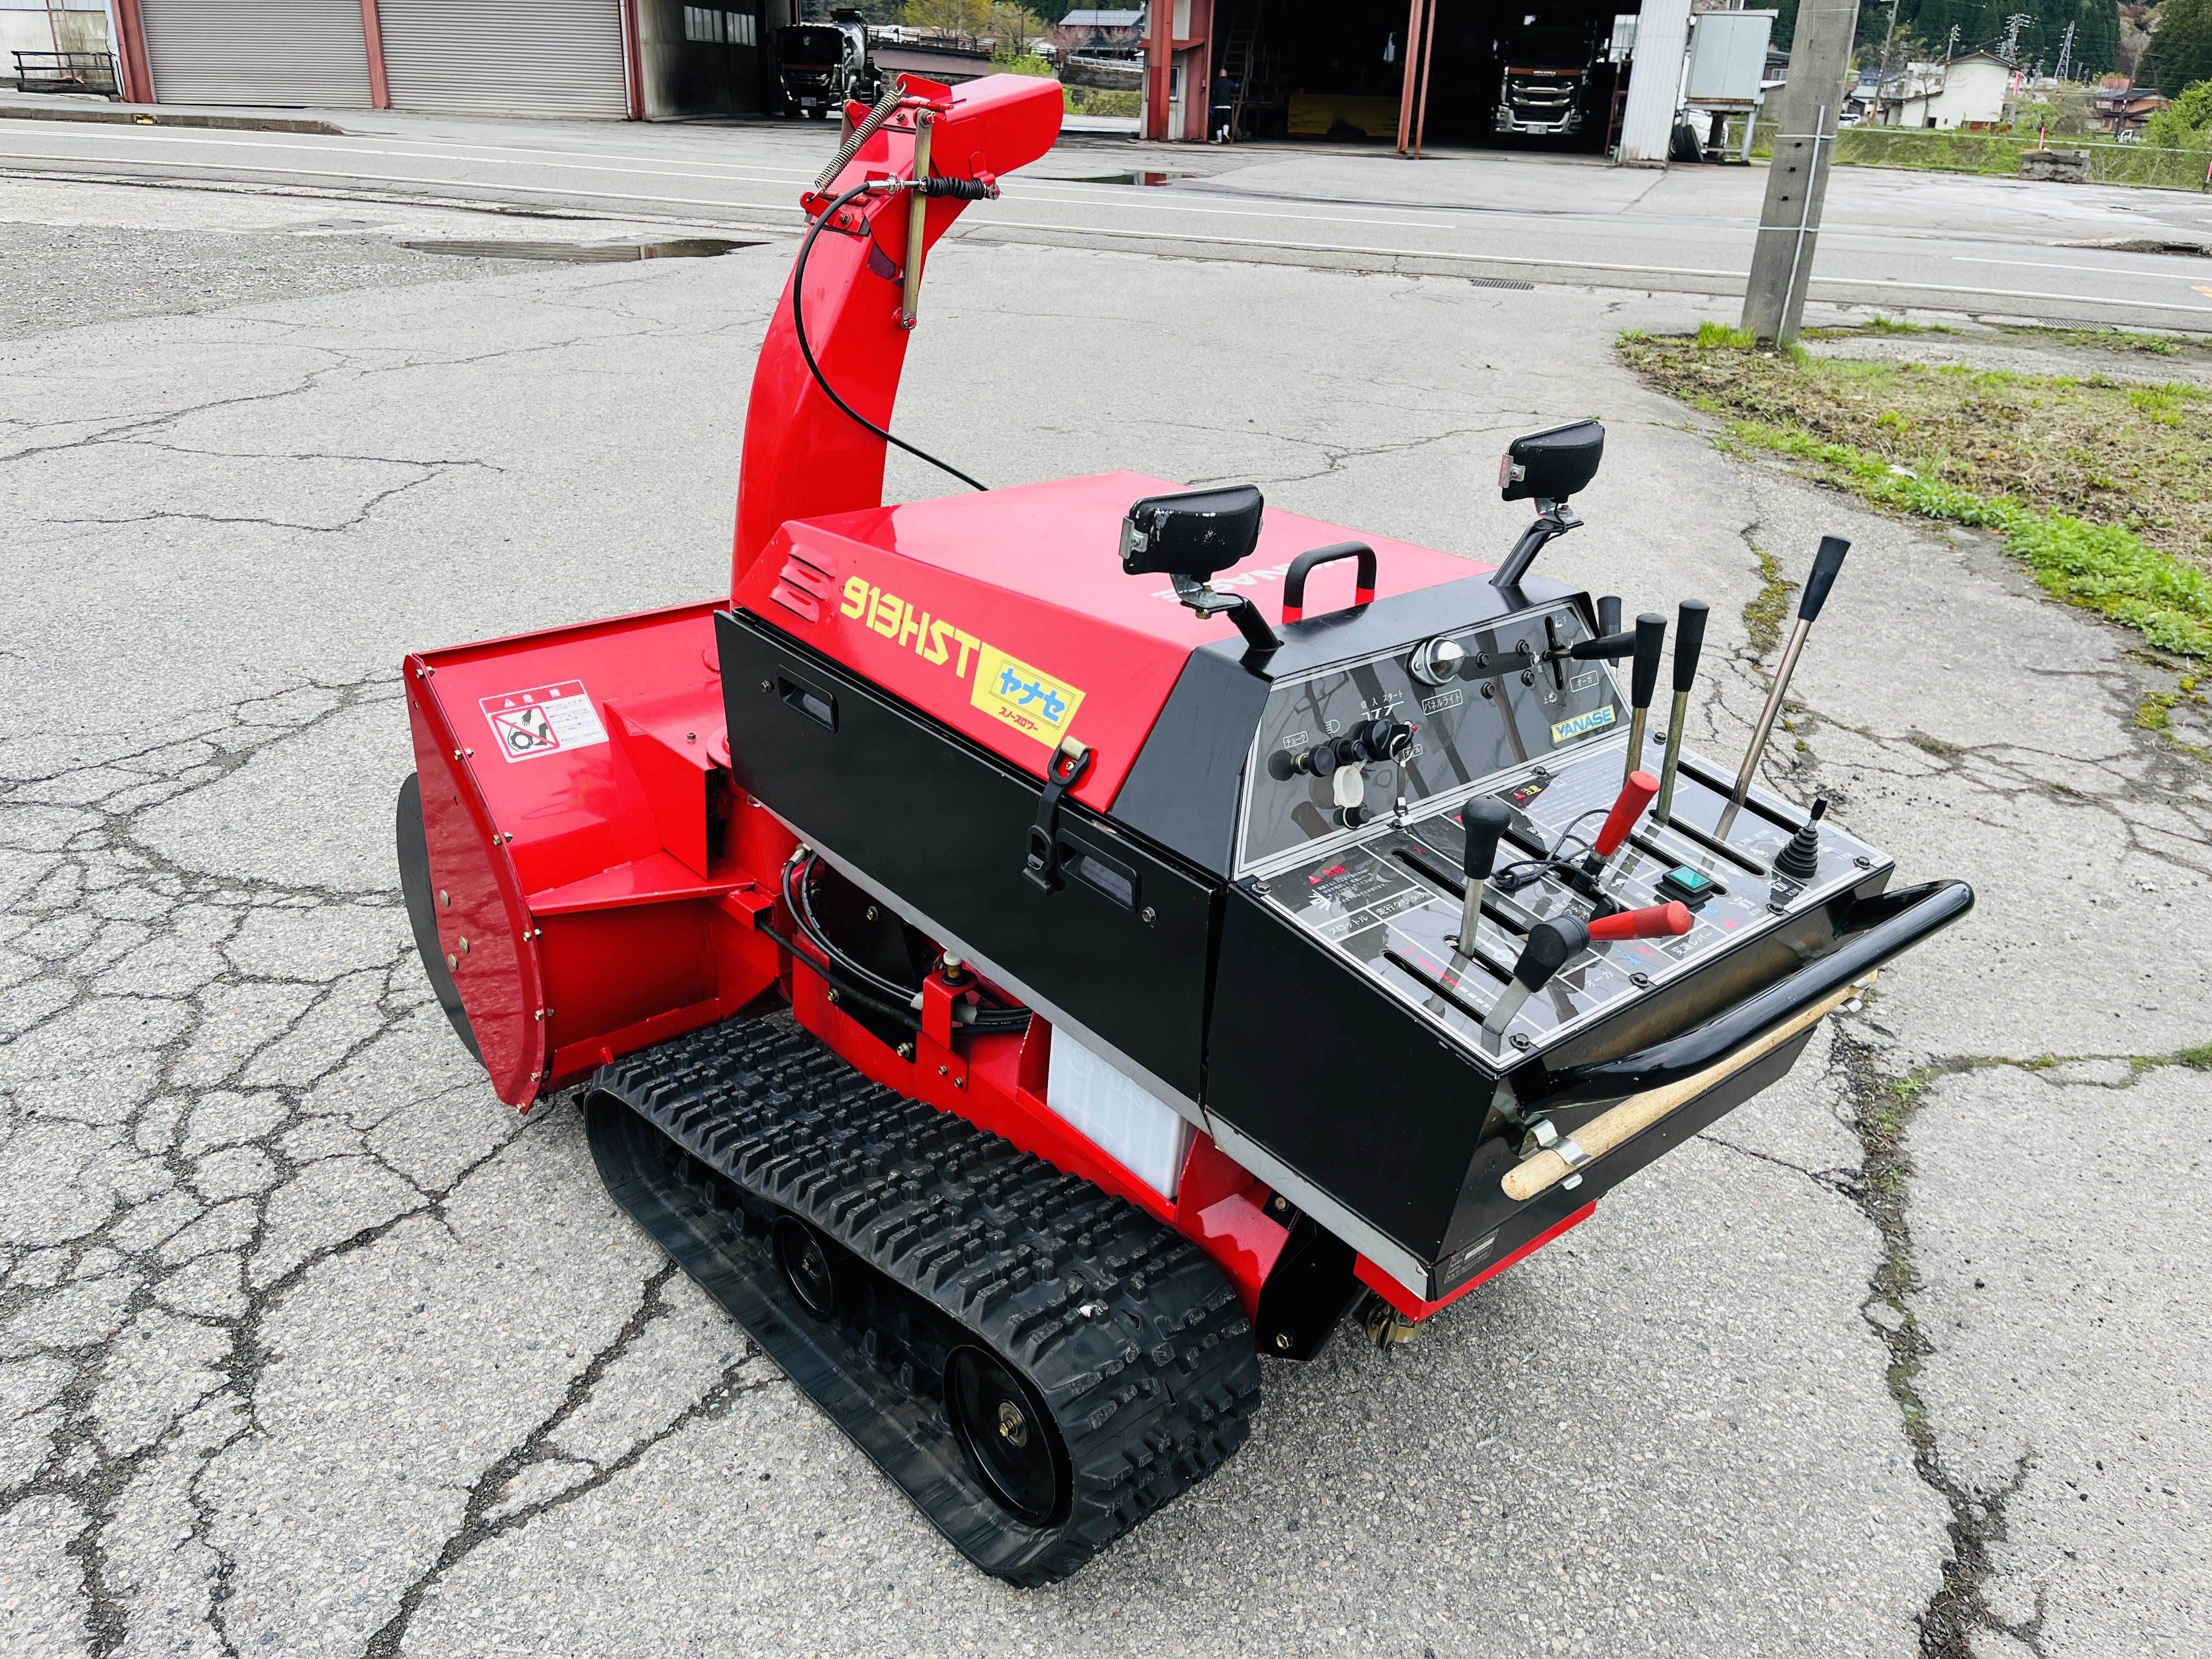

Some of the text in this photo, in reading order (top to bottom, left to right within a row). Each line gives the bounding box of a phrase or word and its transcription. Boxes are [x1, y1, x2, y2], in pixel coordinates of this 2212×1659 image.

[840, 575, 980, 678] 913HST
[1576, 676, 1593, 687] オーガ
[1000, 668, 1065, 723] ヤナセ
[1383, 690, 1403, 703] スタート
[1424, 692, 1462, 712] パネルライト
[998, 706, 1038, 732] スノースロワー
[1555, 708, 1612, 740] YANASE
[1285, 733, 1306, 746] チョーク
[1405, 747, 1421, 757] オル
[1521, 785, 1543, 796] 注意
[1375, 890, 1427, 916] 走行クラッチ
[1328, 916, 1369, 935] スロットル
[1670, 932, 1713, 956] 変速レバー
[1584, 969, 1615, 988] オーガ
